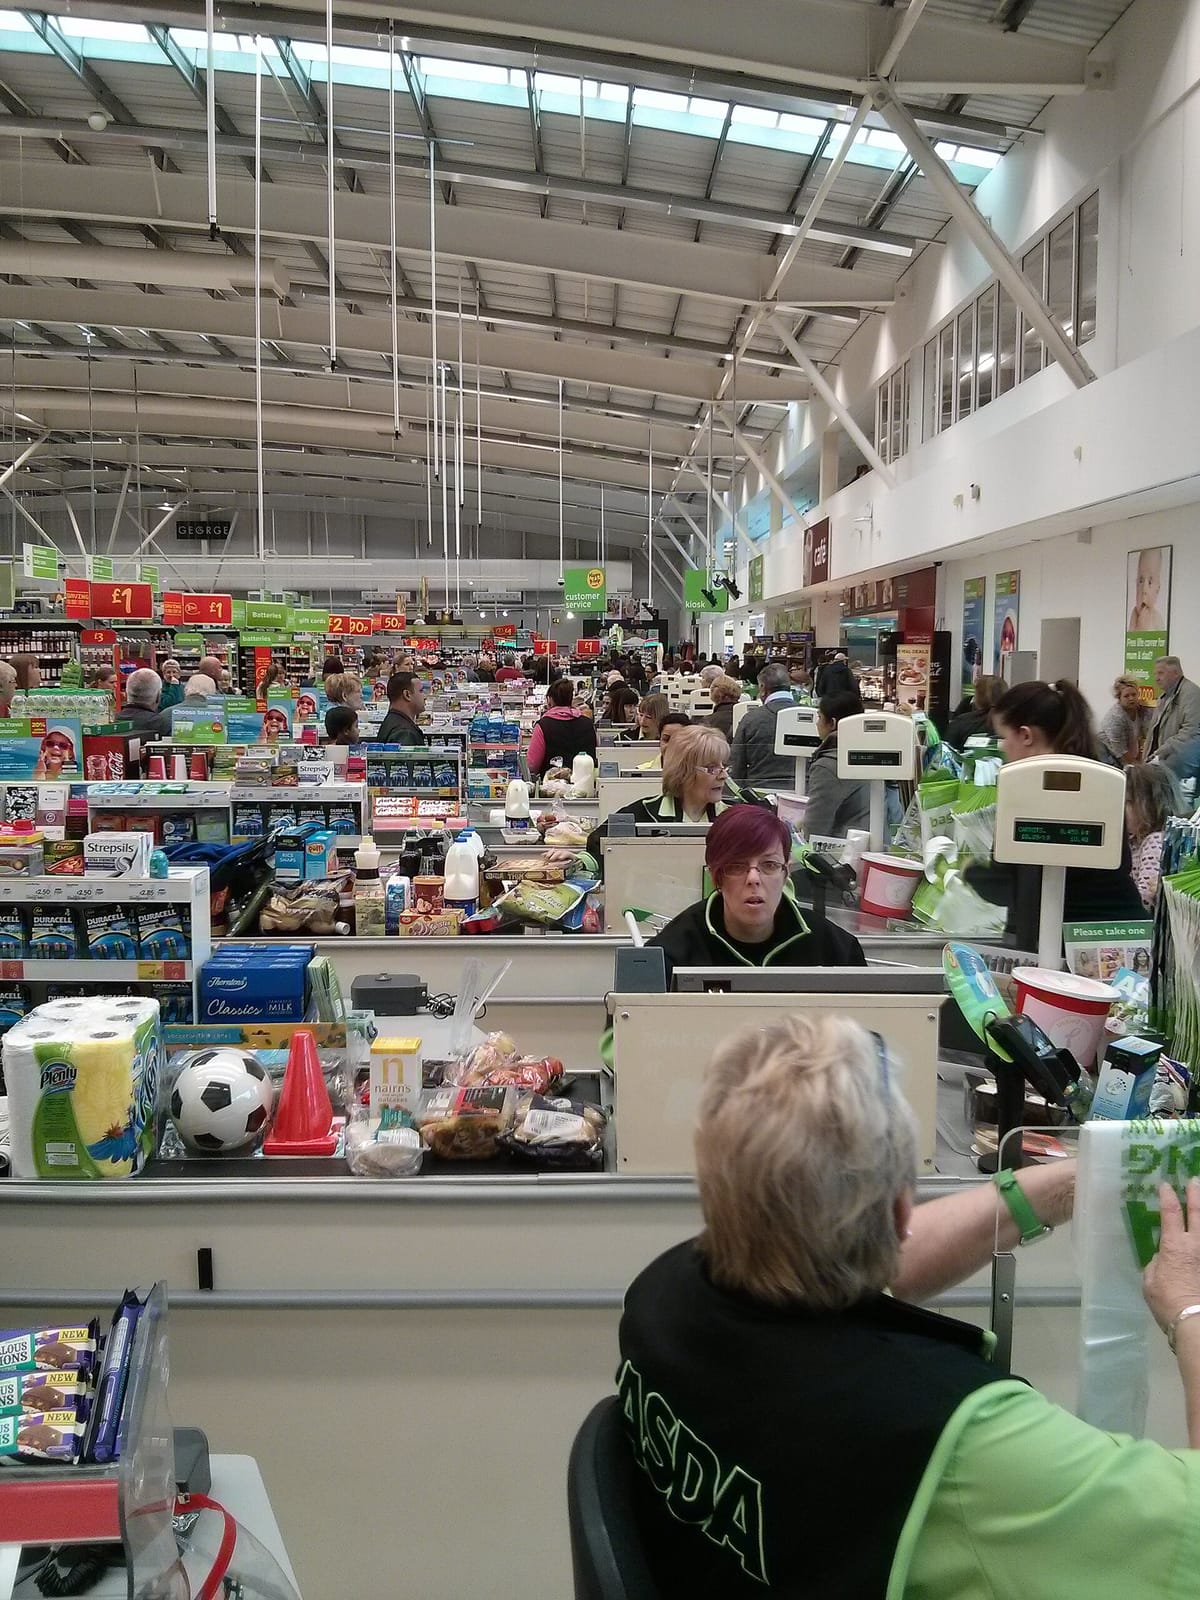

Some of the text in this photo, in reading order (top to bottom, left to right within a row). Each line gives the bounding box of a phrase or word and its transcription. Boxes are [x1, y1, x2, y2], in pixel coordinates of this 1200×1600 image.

[111, 587, 132, 614] £1
[565, 593, 601, 601] customer
[565, 600, 592, 609] service
[685, 600, 705, 609] kiosk
[209, 601, 223, 619] £1
[252, 611, 282, 620] Batteries
[384, 617, 402, 629] 50p
[242, 634, 272, 642] batteries
[87, 842, 134, 855] Strepsils
[33, 916, 73, 924] DURACELL
[86, 912, 126, 926] DURACELL
[137, 908, 177, 924] DURACELL
[1073, 928, 1104, 937] Please
[1105, 927, 1126, 935] take
[207, 998, 264, 1017] Classics
[268, 1003, 293, 1012] MILK
[40, 1066, 78, 1090] Plenty
[61, 1330, 86, 1339] NEW
[49, 1373, 75, 1382] NEW
[47, 1412, 73, 1422] NEW
[617, 1359, 771, 1586] ASDA
